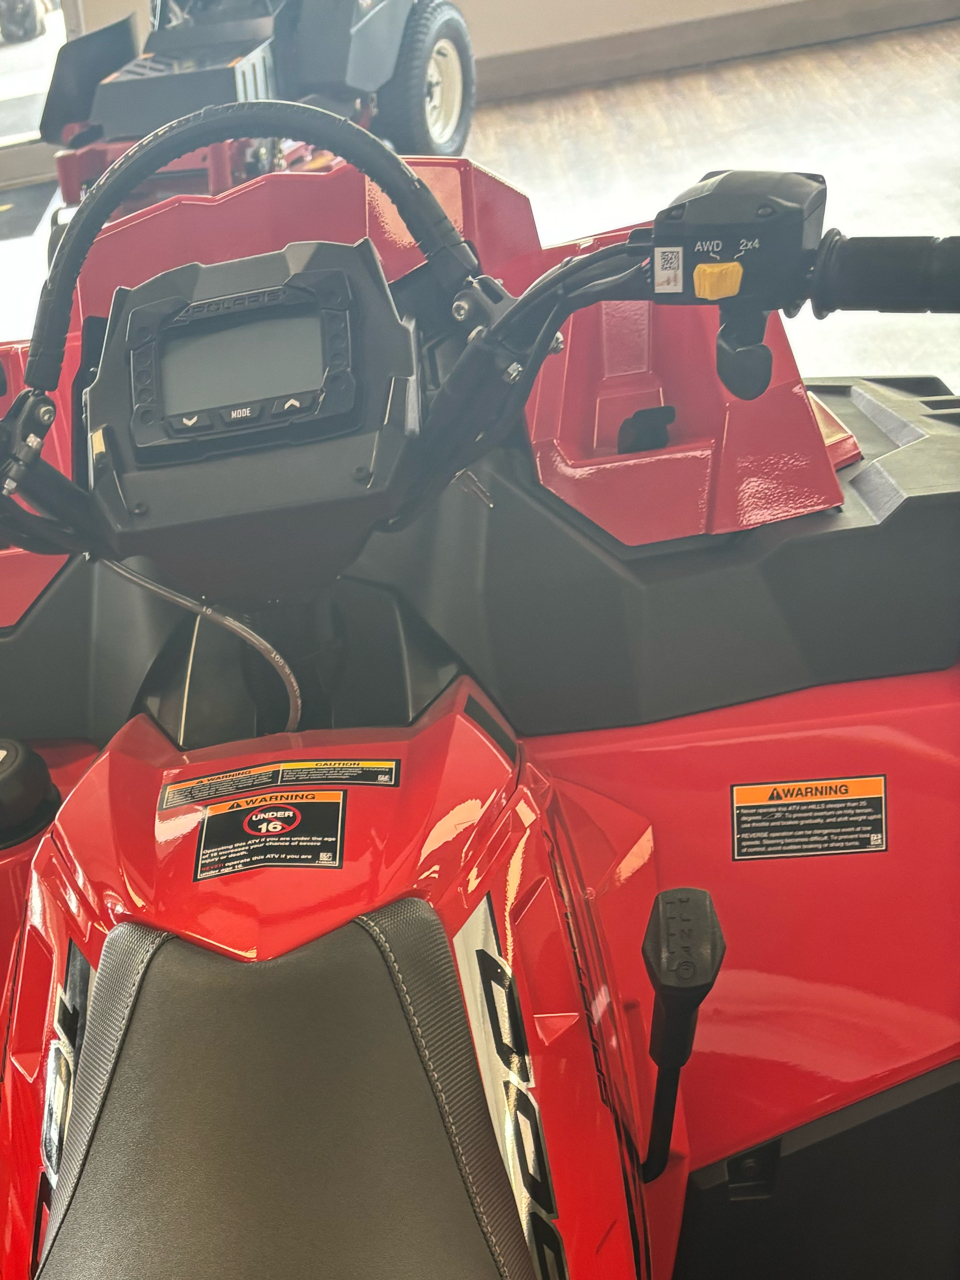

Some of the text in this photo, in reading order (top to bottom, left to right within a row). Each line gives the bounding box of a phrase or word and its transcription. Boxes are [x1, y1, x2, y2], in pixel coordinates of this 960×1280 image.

[694, 240, 722, 252] AWD
[739, 238, 760, 250] 2x4
[231, 407, 251, 419] MODE
[206, 770, 251, 782] WARNING
[782, 784, 849, 799] WARNING
[245, 793, 316, 807] WARNING
[252, 811, 294, 821] UNDER
[257, 821, 283, 834] 16
